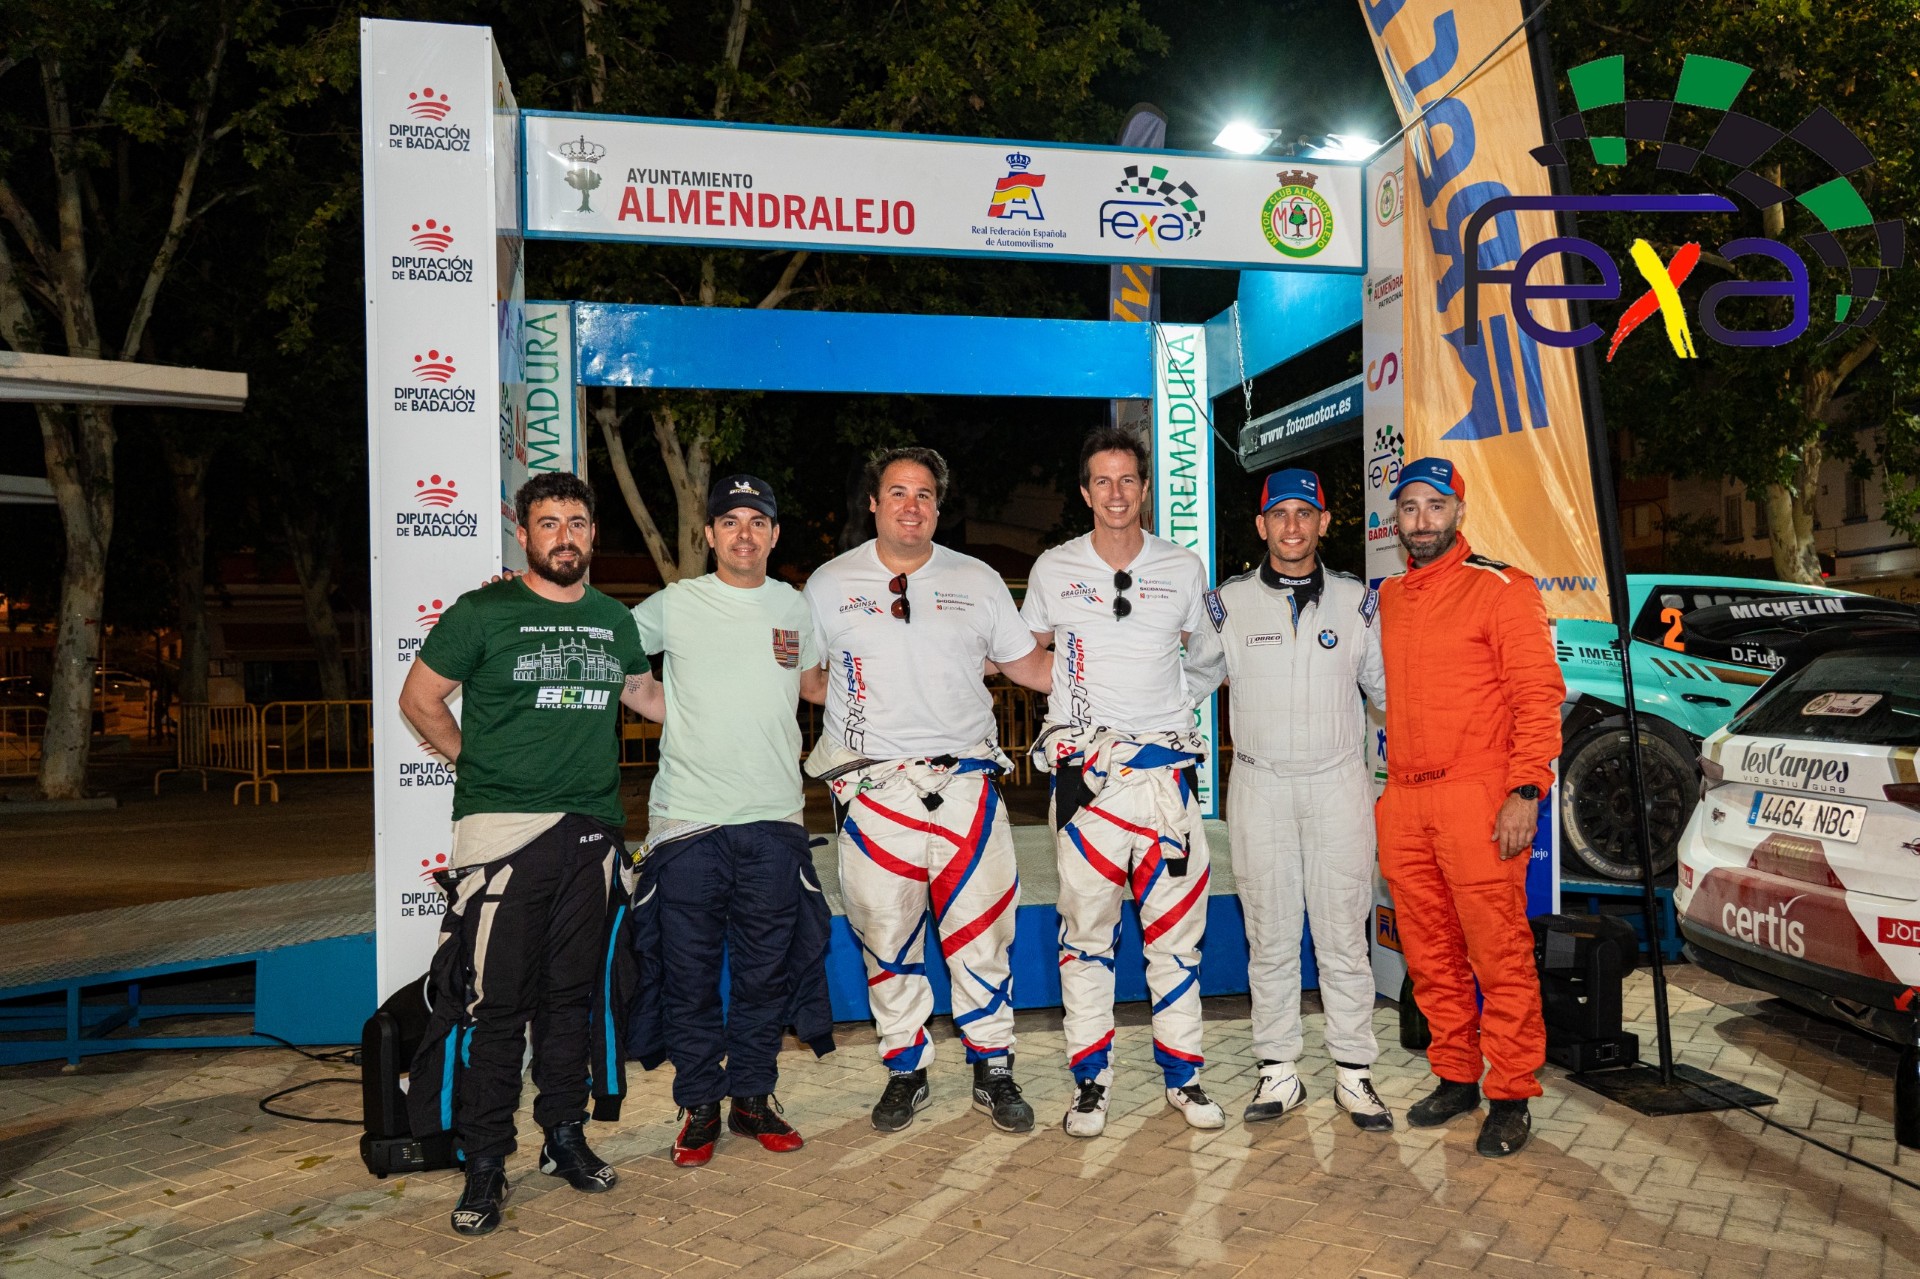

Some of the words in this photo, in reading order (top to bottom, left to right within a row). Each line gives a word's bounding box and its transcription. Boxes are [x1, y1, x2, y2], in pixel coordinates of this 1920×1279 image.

[389, 123, 470, 140] DIPUTACIÓN
[389, 138, 403, 149] DE
[405, 136, 471, 152] BADAJOZ
[627, 168, 753, 189] AYUNTAMIENTO
[1269, 187, 1292, 205] CLUB
[617, 187, 916, 236] ALMENDRALEJO
[1294, 187, 1331, 248] ALMENDRALEJO
[971, 226, 988, 235] Real
[989, 227, 1031, 237] Federación
[1033, 228, 1067, 239] Española
[1262, 211, 1279, 246] MOTOR
[985, 238, 995, 246] de
[996, 239, 1054, 248] Automovilismo
[391, 254, 473, 271] DIPUTACIÓN
[392, 269, 405, 281] DE
[408, 267, 473, 283] BADAJOZ
[1373, 275, 1403, 301] ALMENDRA
[394, 385, 475, 400] DIPUTACIÓN
[525, 311, 560, 474] MADURA
[394, 402, 408, 411] DE
[411, 400, 475, 412] BADAJOZ
[1167, 333, 1198, 548] TREMADURA
[396, 510, 477, 525] DIPUTACIÓN
[396, 528, 410, 537] DE
[413, 525, 477, 537] BADAJOZ
[1368, 524, 1400, 542] BARRAG
[1060, 588, 1097, 598] GRAGINSA
[839, 600, 877, 612] GRAGINSA
[1728, 598, 1846, 620] MICHELIN
[1660, 607, 1685, 651] 2
[398, 653, 411, 662] DE
[1580, 658, 1623, 667] HOSPITALE
[1730, 647, 1786, 667] D.Fuen
[400, 763, 455, 775] DIPUTAC
[1414, 768, 1446, 784] CASTILLA
[400, 778, 413, 787] DE
[416, 774, 455, 786] BADA
[1812, 784, 1845, 793] GURB
[1761, 797, 1806, 828] 4464
[1813, 805, 1854, 837] NBC
[1583, 851, 1633, 876] MICHELIN
[402, 892, 448, 905] DIPUTA
[402, 908, 414, 917] DE
[1722, 894, 1806, 958] certis
